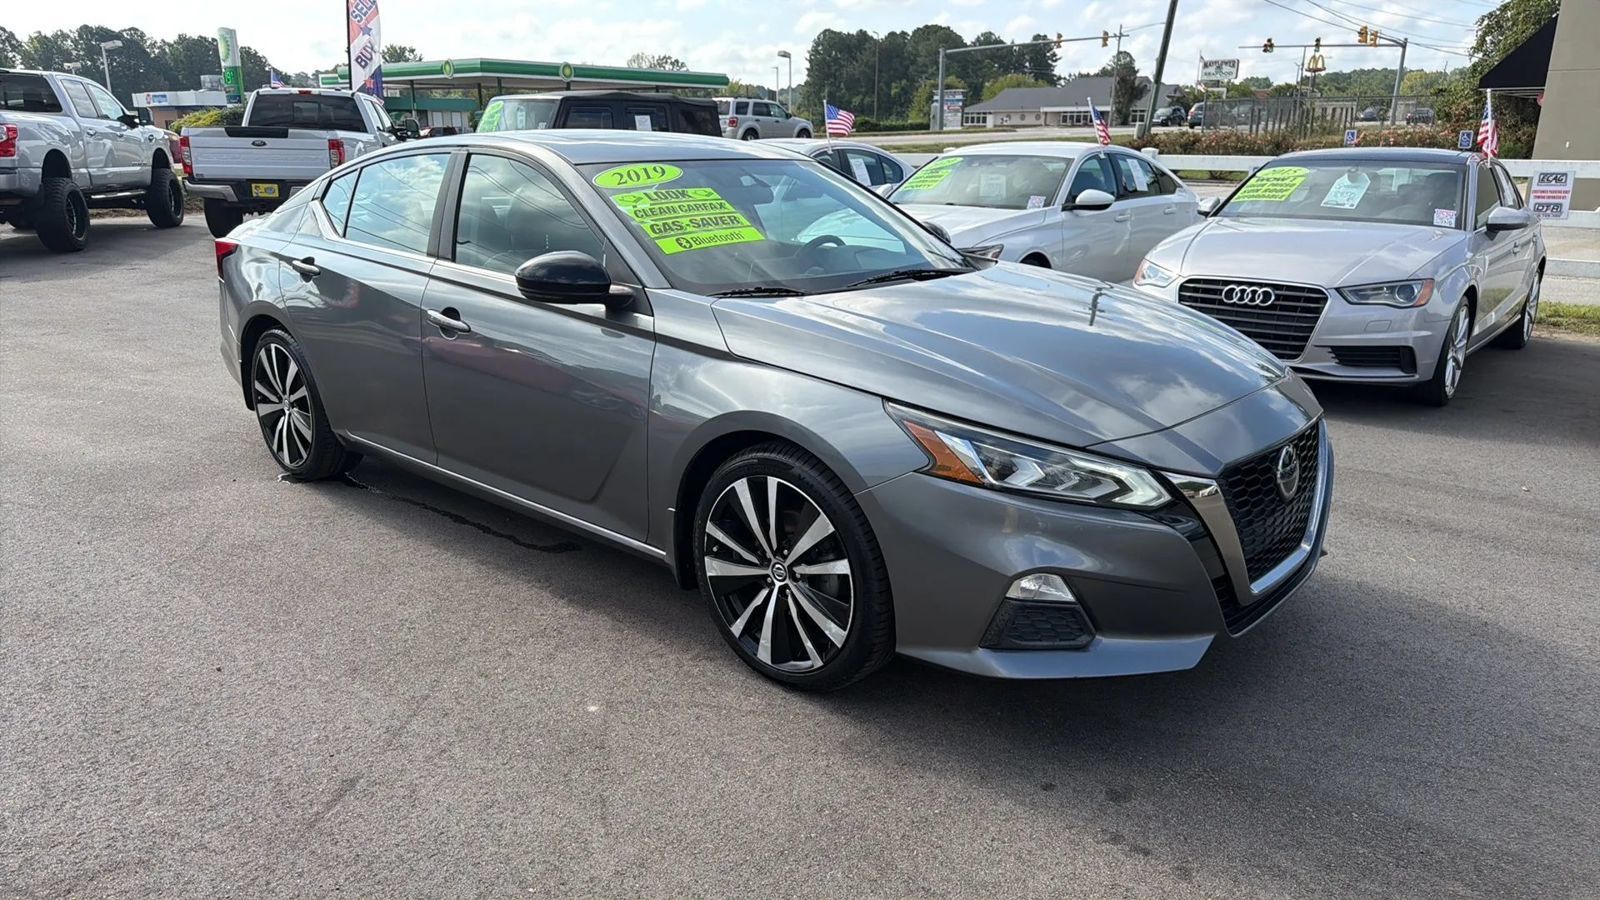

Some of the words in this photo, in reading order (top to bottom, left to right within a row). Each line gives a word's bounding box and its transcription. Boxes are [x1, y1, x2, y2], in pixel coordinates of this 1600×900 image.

[355, 40, 377, 69] BUY
[611, 165, 667, 186] 2019
[642, 189, 693, 201] LOOK
[633, 205, 678, 220] CLEAN
[678, 201, 726, 213] CARFAX
[690, 231, 745, 247] Bluetooth
